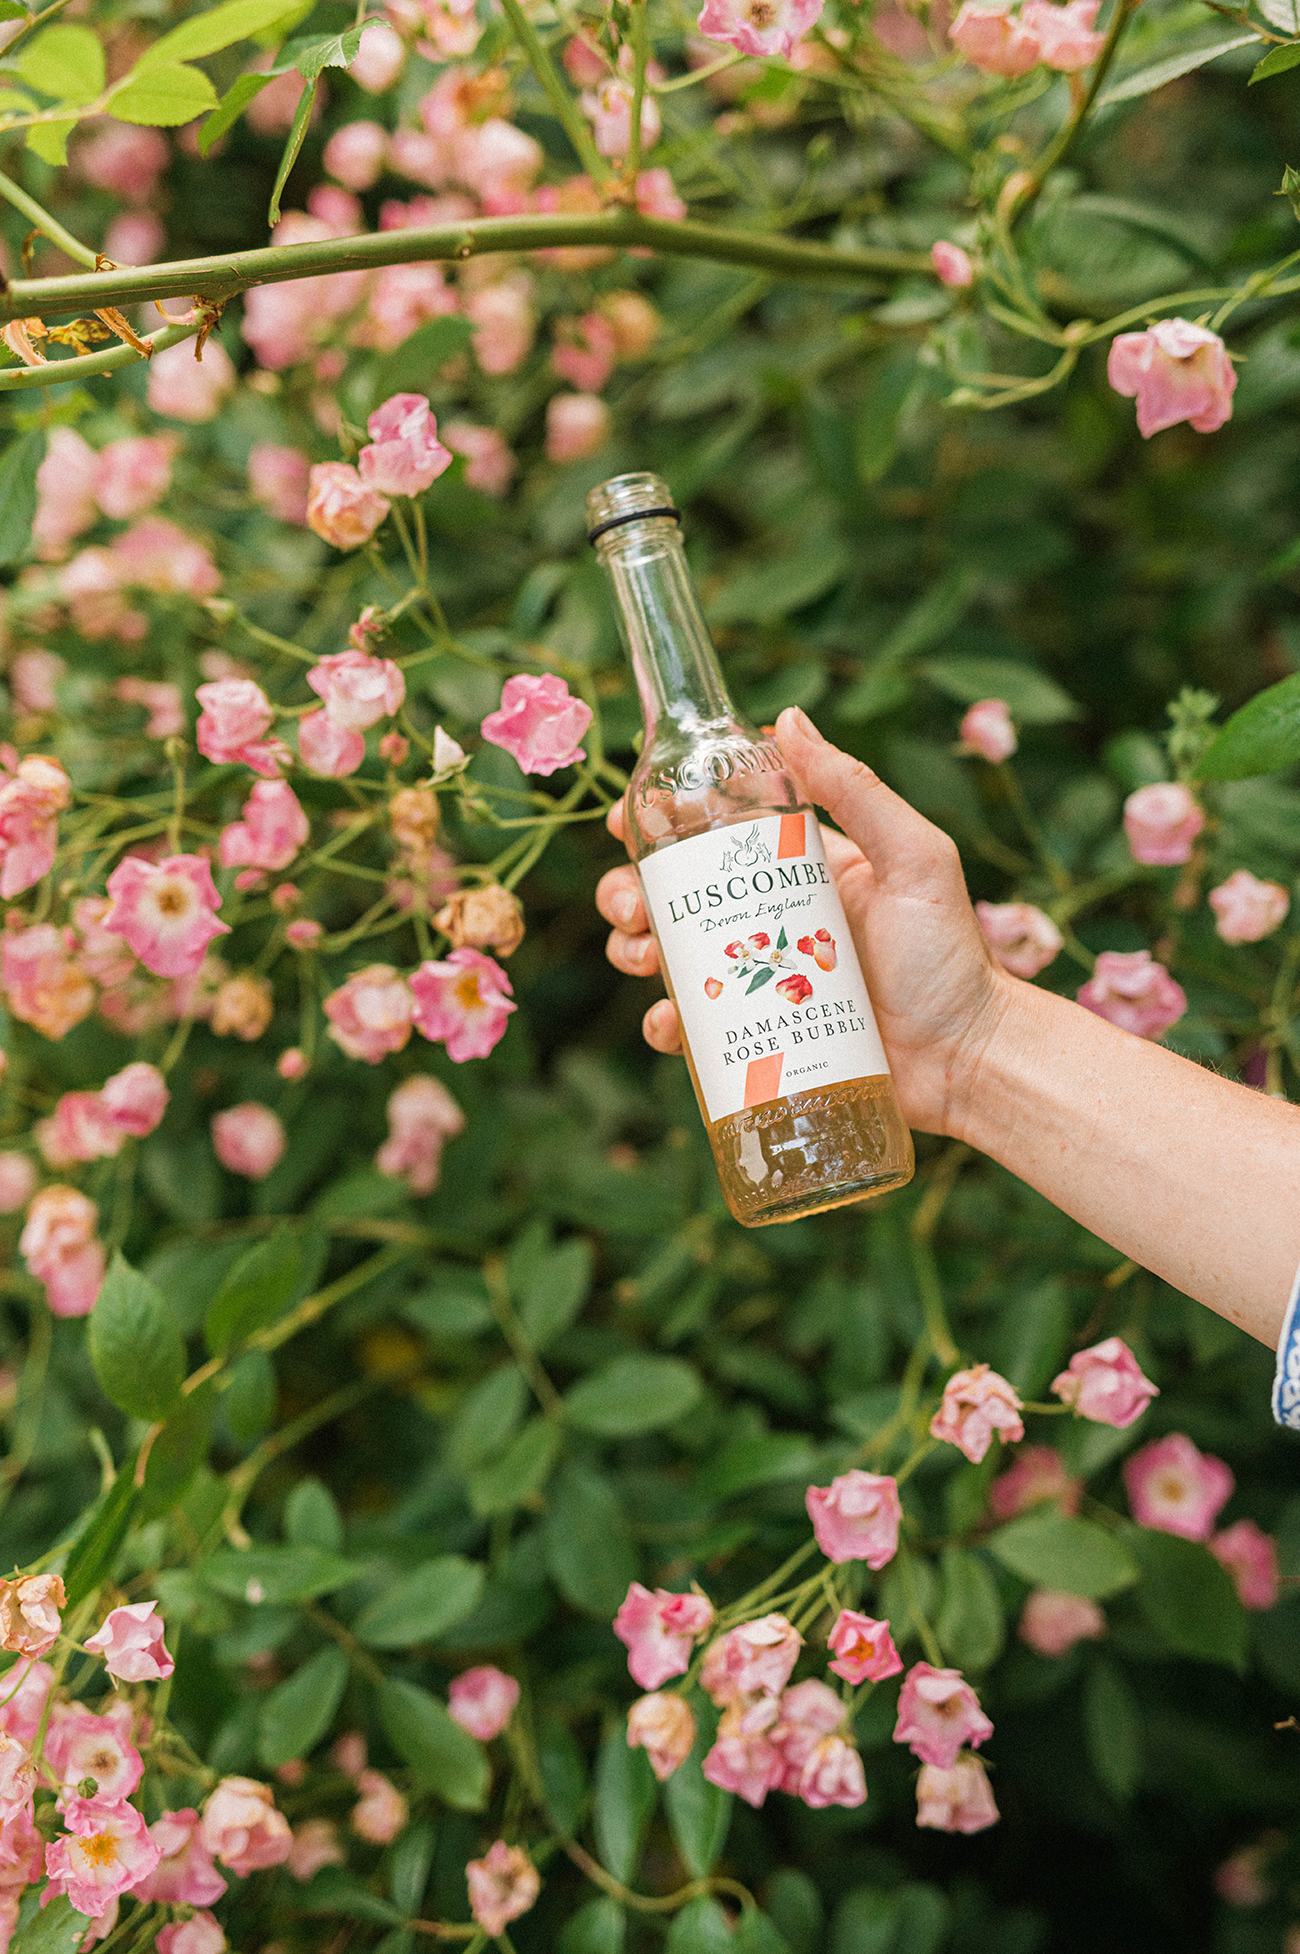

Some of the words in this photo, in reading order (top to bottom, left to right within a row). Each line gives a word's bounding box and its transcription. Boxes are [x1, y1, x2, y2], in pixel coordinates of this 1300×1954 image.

[668, 862, 830, 923] LUSCOMBE
[700, 911, 751, 933] Devon
[755, 893, 817, 920] England
[723, 1037, 780, 1066] ROSE
[791, 1017, 866, 1045] BUBBLY
[725, 999, 857, 1045] DAMASCENE
[785, 1060, 829, 1078] ORGANIC
